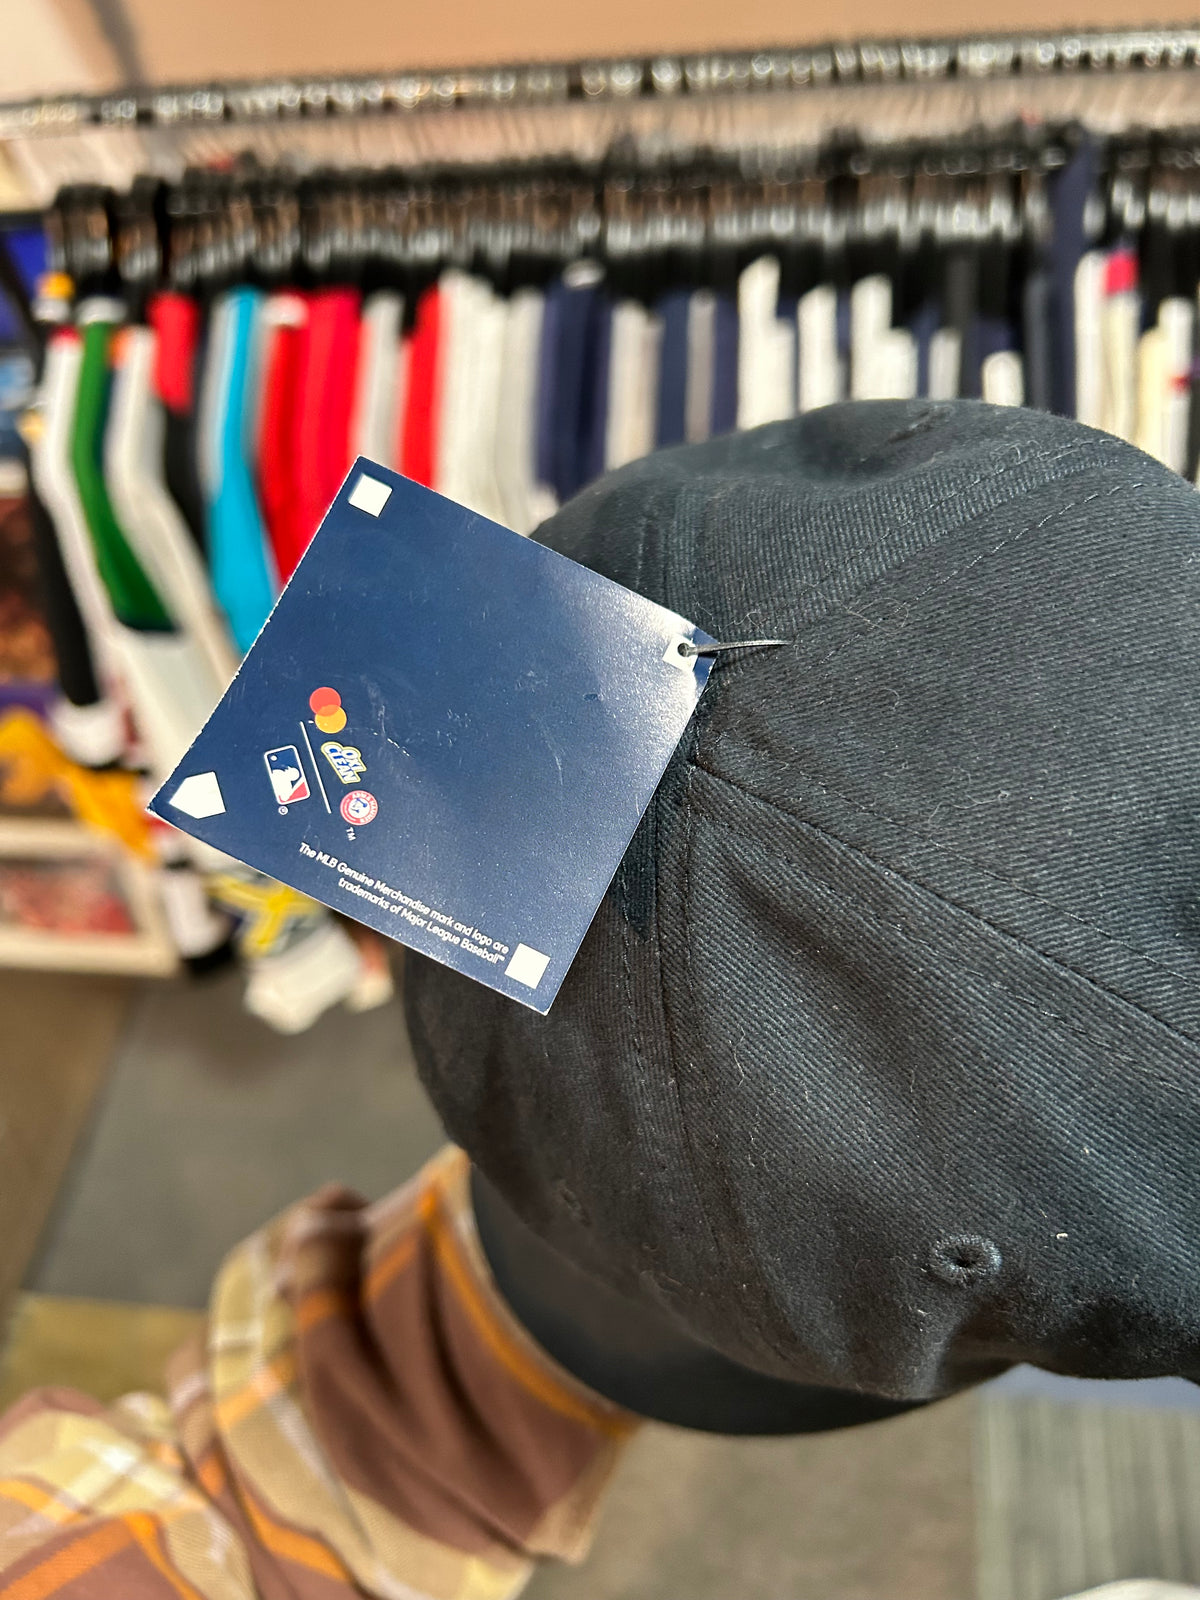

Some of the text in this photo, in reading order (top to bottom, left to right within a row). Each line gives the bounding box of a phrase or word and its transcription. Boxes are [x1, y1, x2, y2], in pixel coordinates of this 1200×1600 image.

[324, 744, 359, 781] CLEAN
[341, 749, 364, 771] OXI
[298, 842, 510, 955] The MLB Genuine Merchandise mark and logo are
[338, 877, 390, 910] trademarks
[389, 902, 403, 915] of
[401, 908, 429, 930] Major
[427, 921, 461, 946] League
